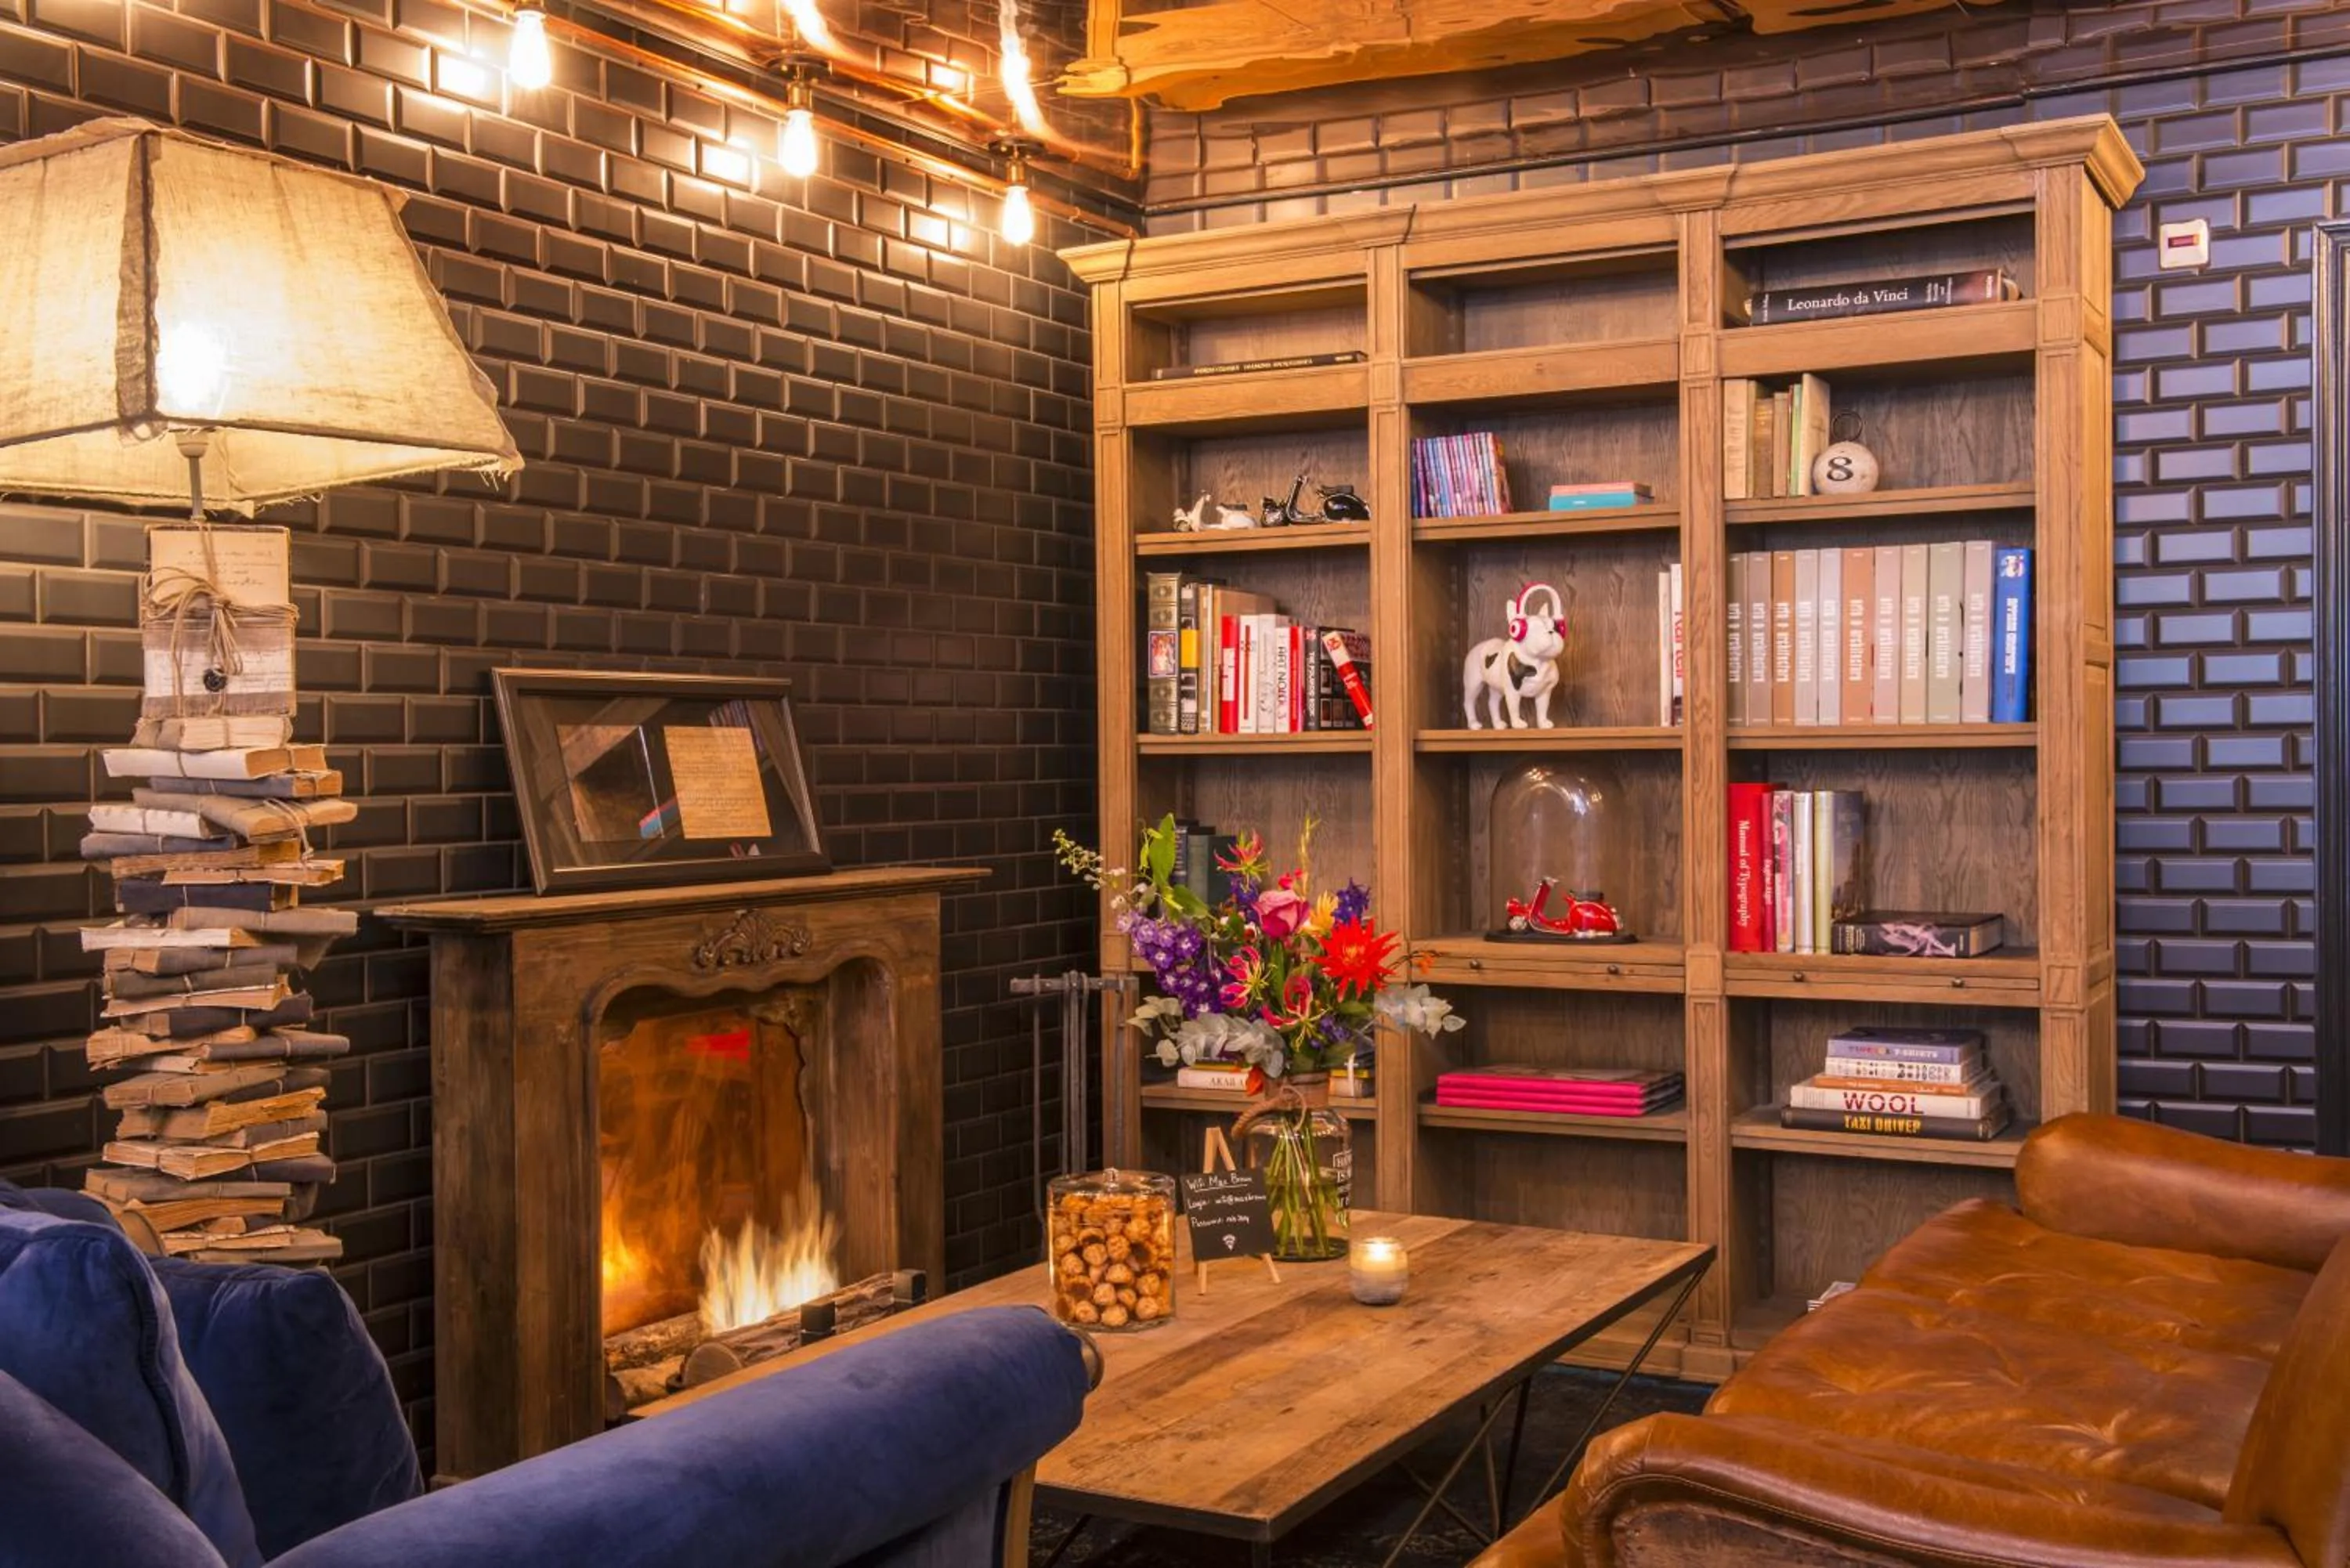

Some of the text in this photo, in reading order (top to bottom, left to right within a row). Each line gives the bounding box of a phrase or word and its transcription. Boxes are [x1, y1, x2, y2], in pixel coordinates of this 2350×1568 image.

[1787, 292, 1849, 311] Leonardo
[1853, 291, 1869, 305] da
[1873, 287, 1908, 302] Vinci
[1826, 457, 1853, 481] 8
[1735, 820, 1751, 927] Manual of Typography
[1842, 1092, 1925, 1115] WOOL
[1843, 1115, 1922, 1134] TAXI DRIVER
